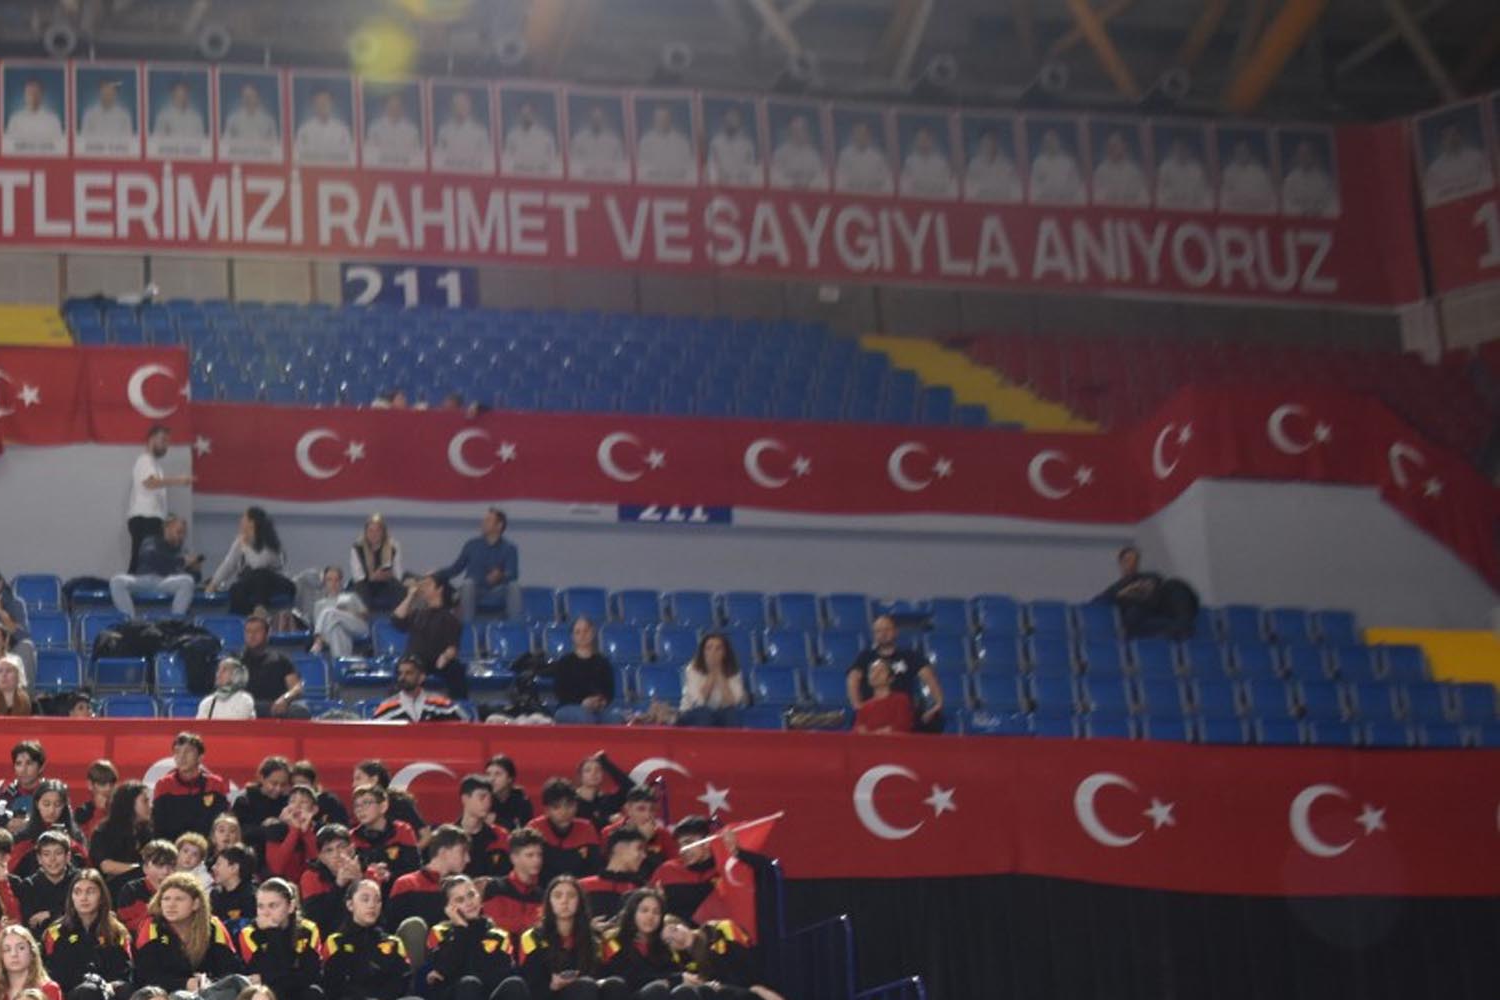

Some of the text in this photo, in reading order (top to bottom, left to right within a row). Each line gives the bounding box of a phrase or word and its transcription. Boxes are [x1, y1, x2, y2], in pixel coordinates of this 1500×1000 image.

[317, 180, 591, 257] RAHMET
[604, 196, 693, 263] VE
[703, 195, 1018, 279] SAYGIYLA
[1032, 216, 1338, 294] ANIYORUZ
[345, 265, 462, 309] 211
